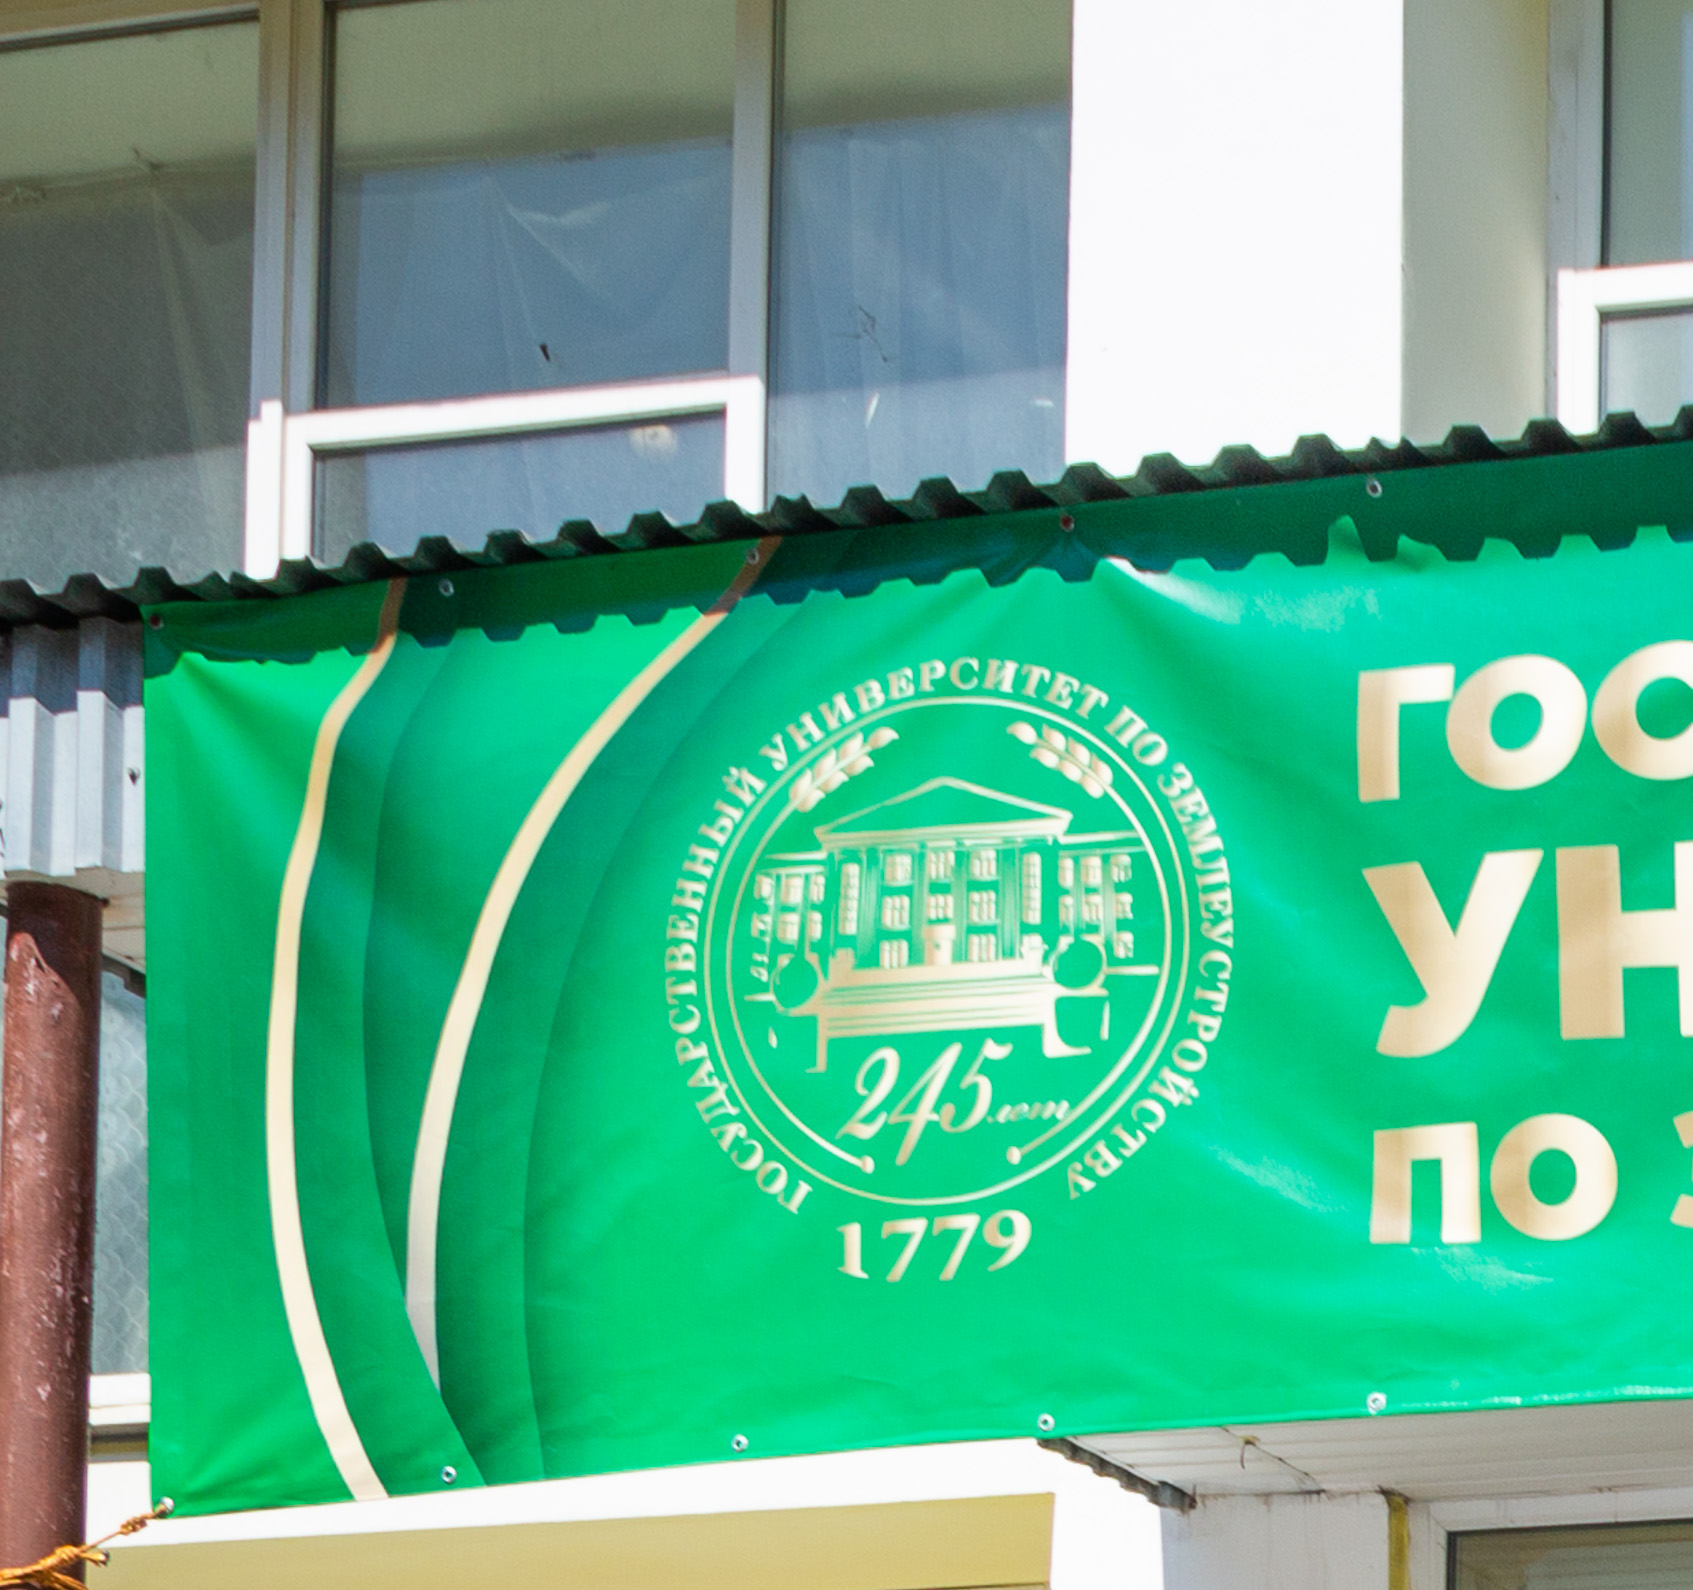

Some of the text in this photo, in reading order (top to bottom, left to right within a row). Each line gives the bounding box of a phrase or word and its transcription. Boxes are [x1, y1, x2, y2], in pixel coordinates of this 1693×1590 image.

[664, 656, 1236, 1216] ГОСУДАРСТВЕННЫЙ УНИВЕРСИТЕТ ПО ЗЕМЛЕУСТРОЙСТВУ
[834, 1037, 1015, 1167] 245
[836, 1207, 1034, 1283] 1779
[1369, 1112, 1619, 1246] ПО
